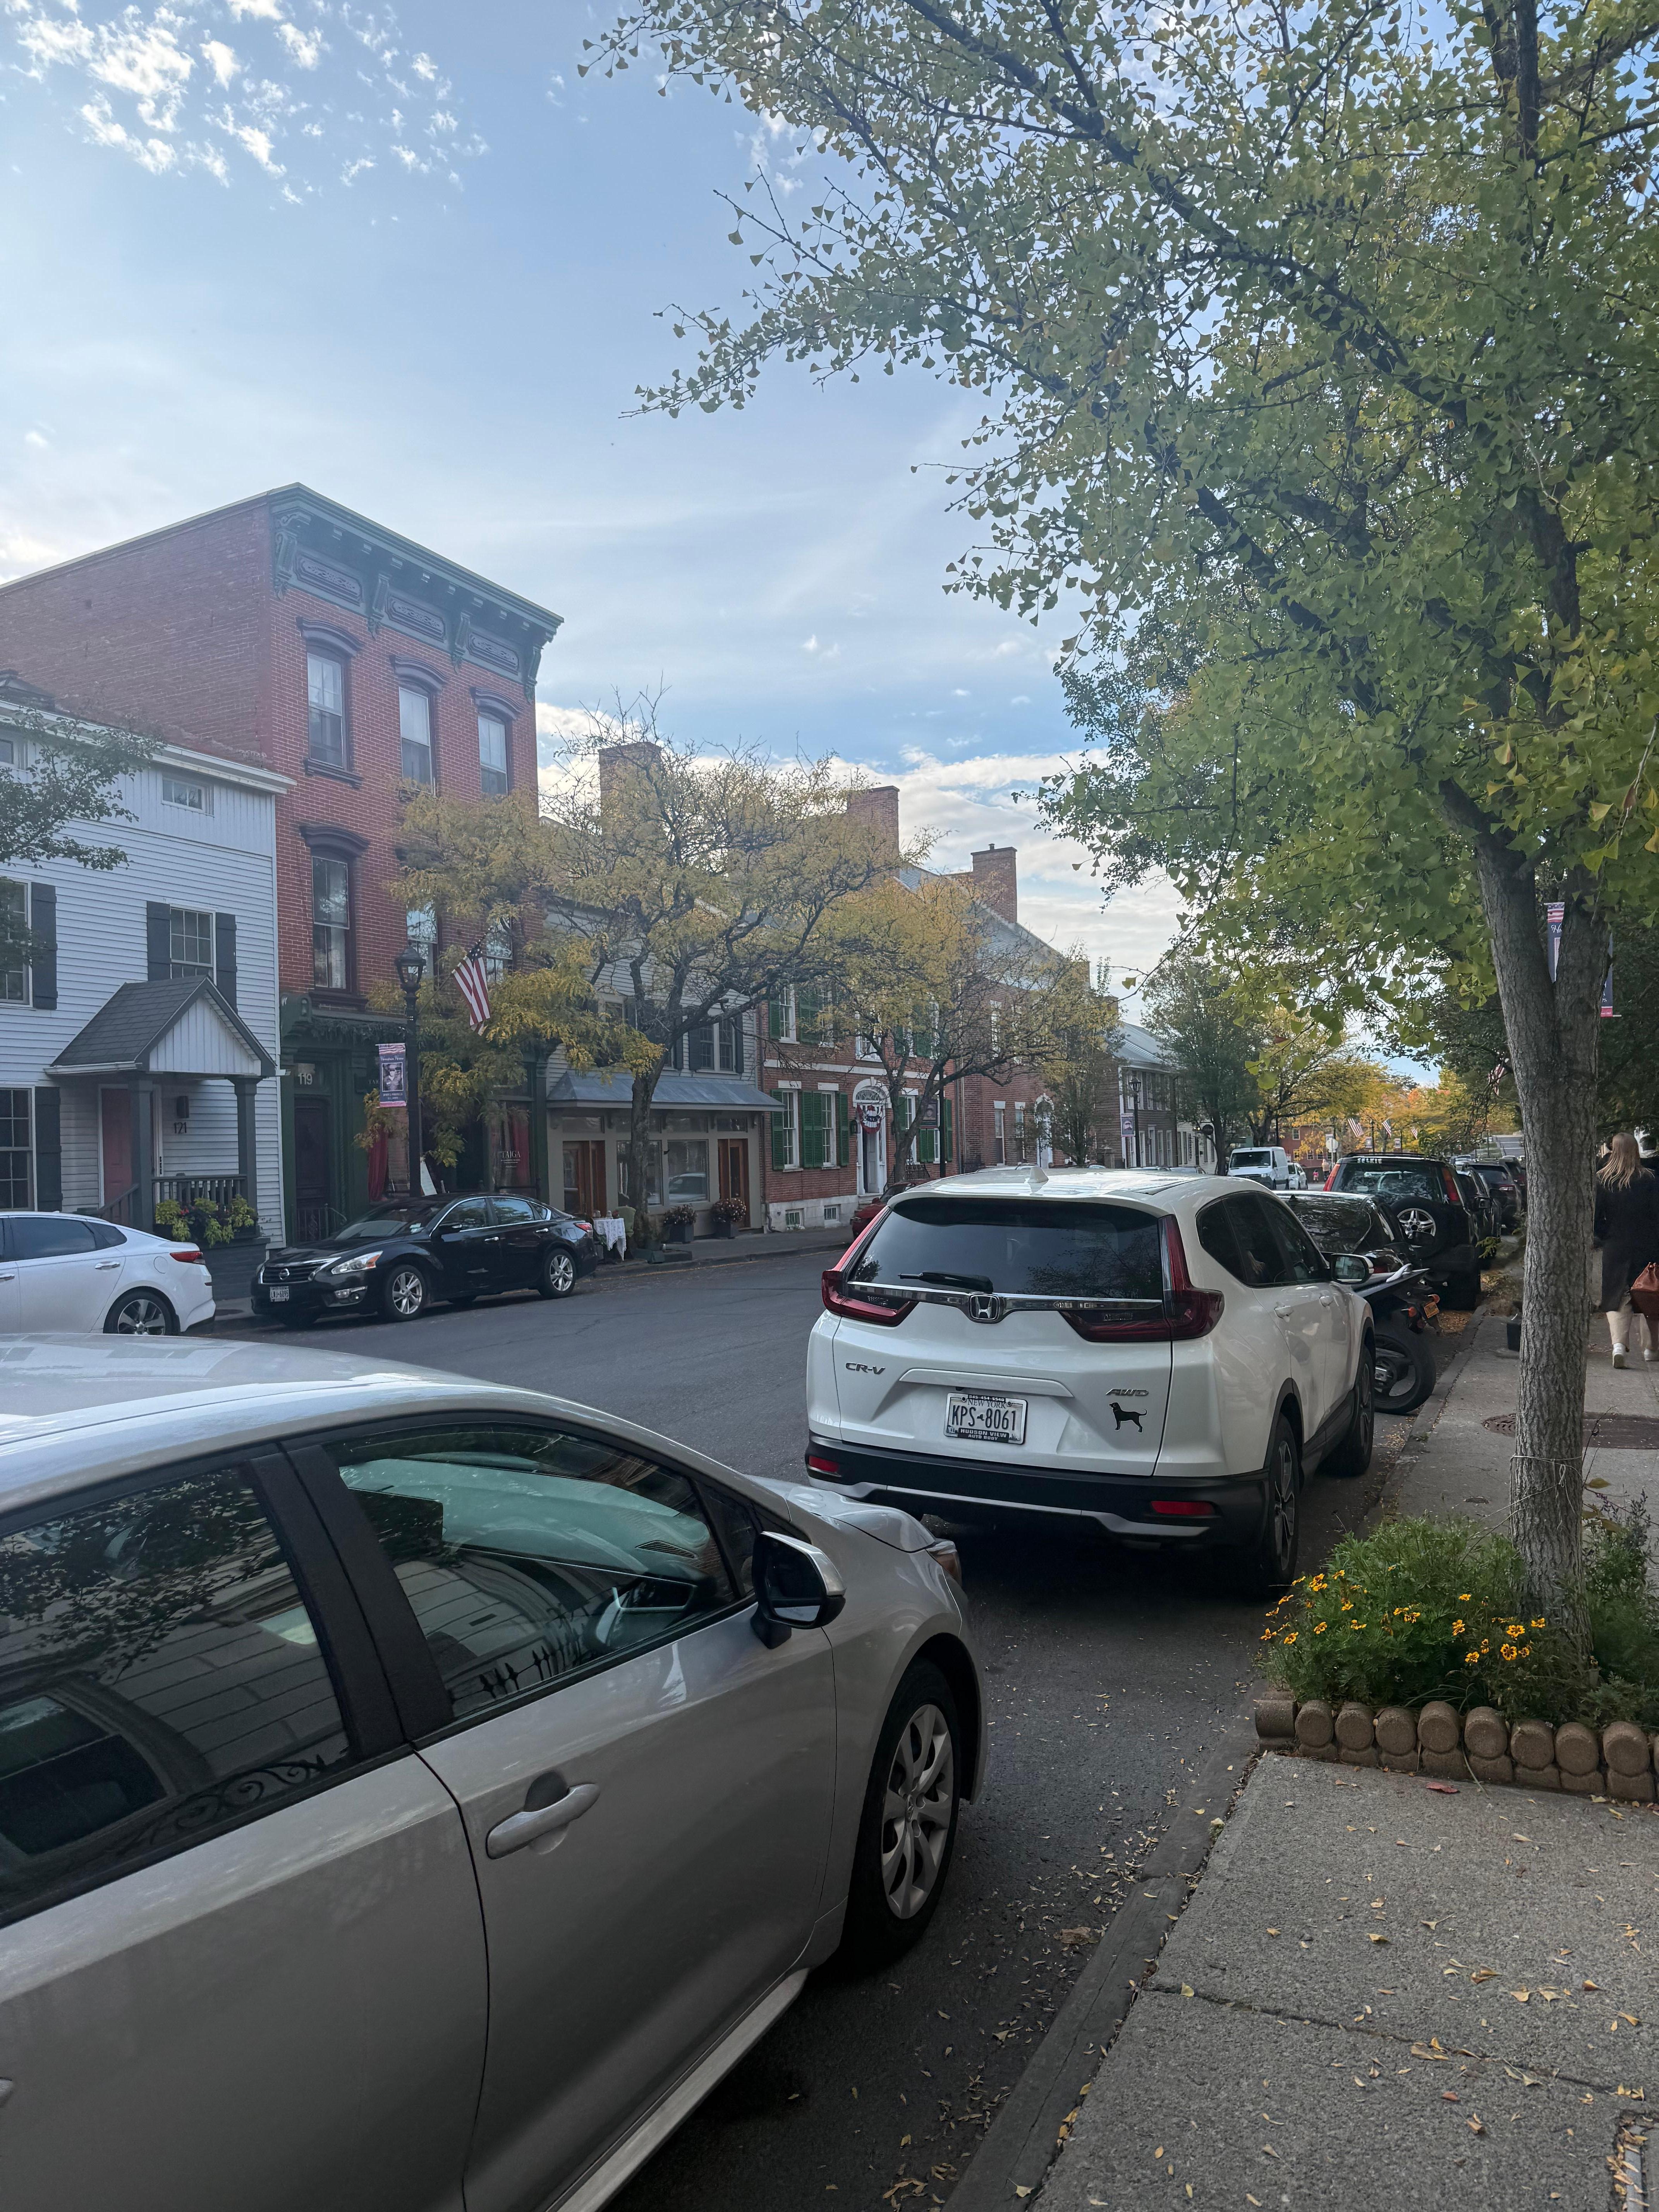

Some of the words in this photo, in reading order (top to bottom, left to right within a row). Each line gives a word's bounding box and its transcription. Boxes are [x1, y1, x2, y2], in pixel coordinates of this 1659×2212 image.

[298, 1073, 313, 1085] 119
[174, 1122, 187, 1134] 121
[846, 1362, 886, 1375] CR-V
[1106, 1388, 1149, 1396] AWD
